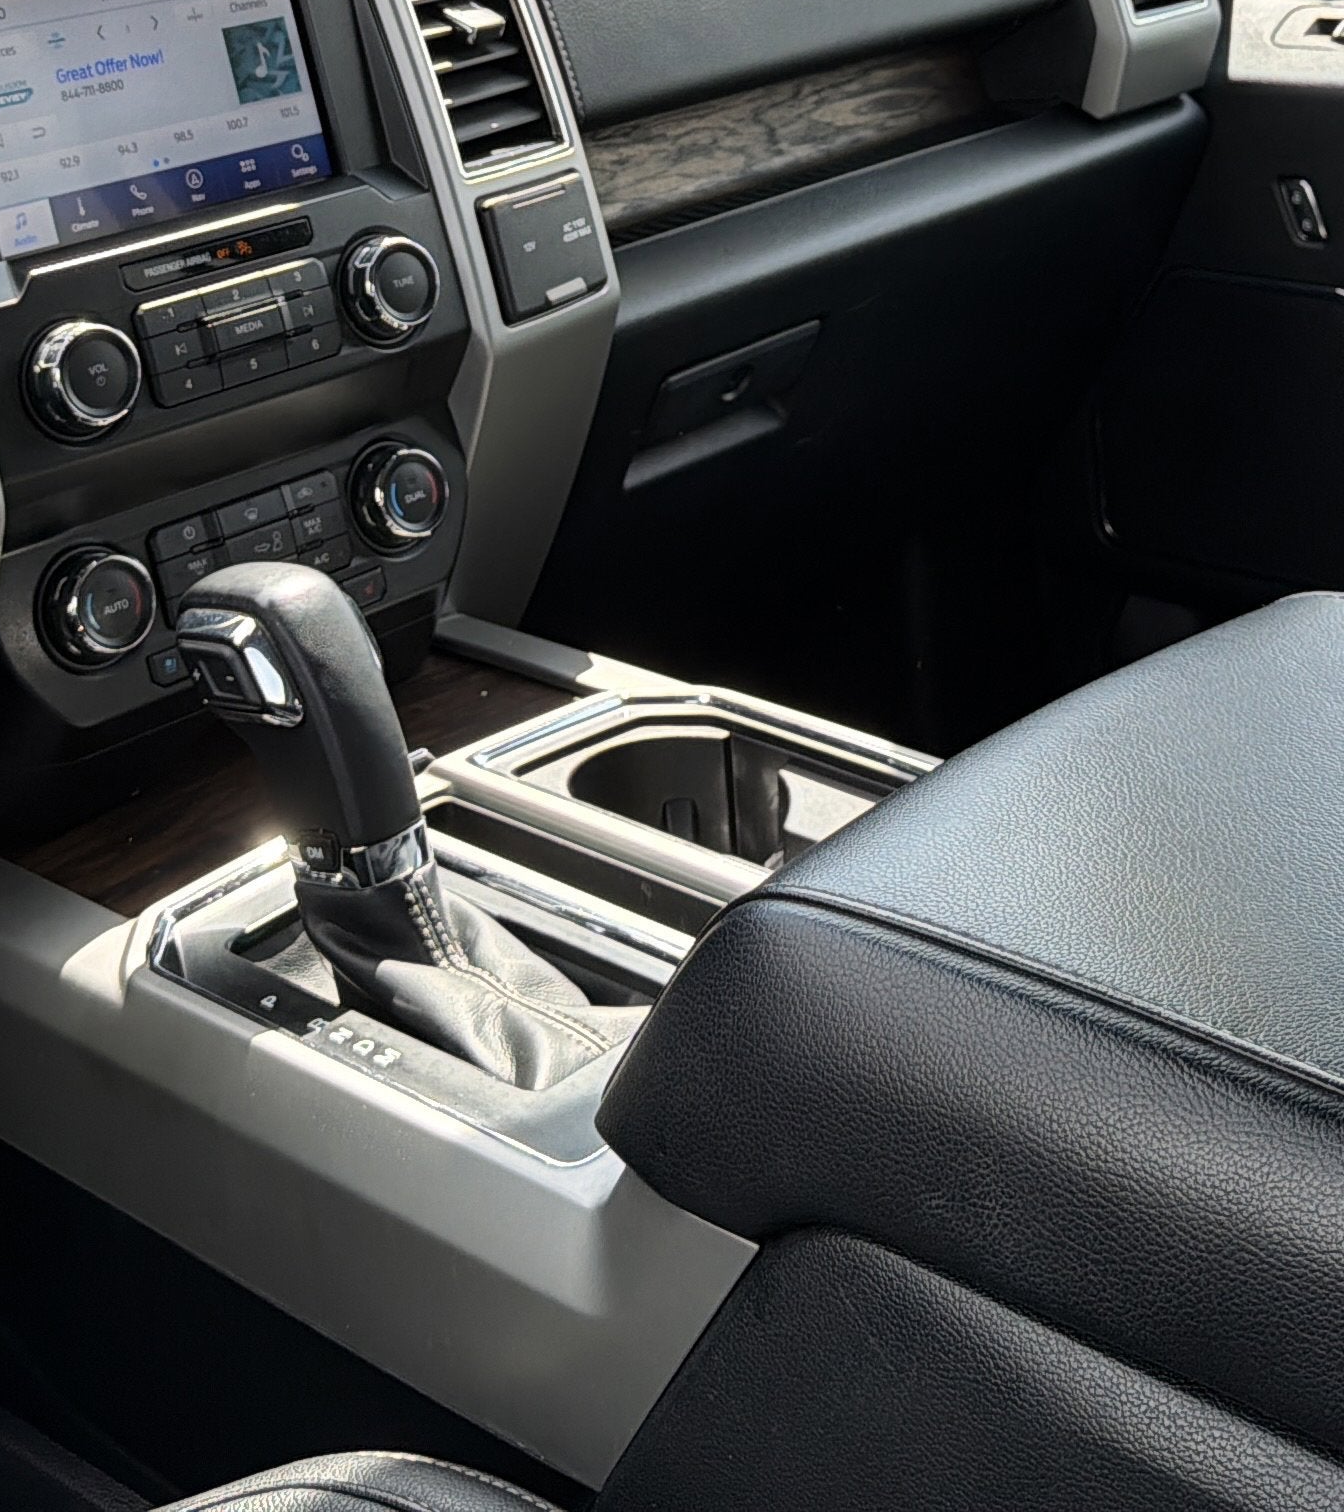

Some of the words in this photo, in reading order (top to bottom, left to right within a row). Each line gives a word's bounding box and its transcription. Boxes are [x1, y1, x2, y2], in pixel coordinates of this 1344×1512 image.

[56, 64, 93, 84] Great
[94, 56, 128, 75] Offer
[130, 49, 164, 69] Now!
[131, 206, 154, 217] Phone
[216, 248, 231, 260] OFF
[294, 271, 302, 282] 3
[232, 289, 240, 300] 2
[235, 318, 264, 335] MEDIA
[88, 363, 108, 376] VOL
[104, 599, 129, 615] AUTO
[261, 995, 277, 1009] P
